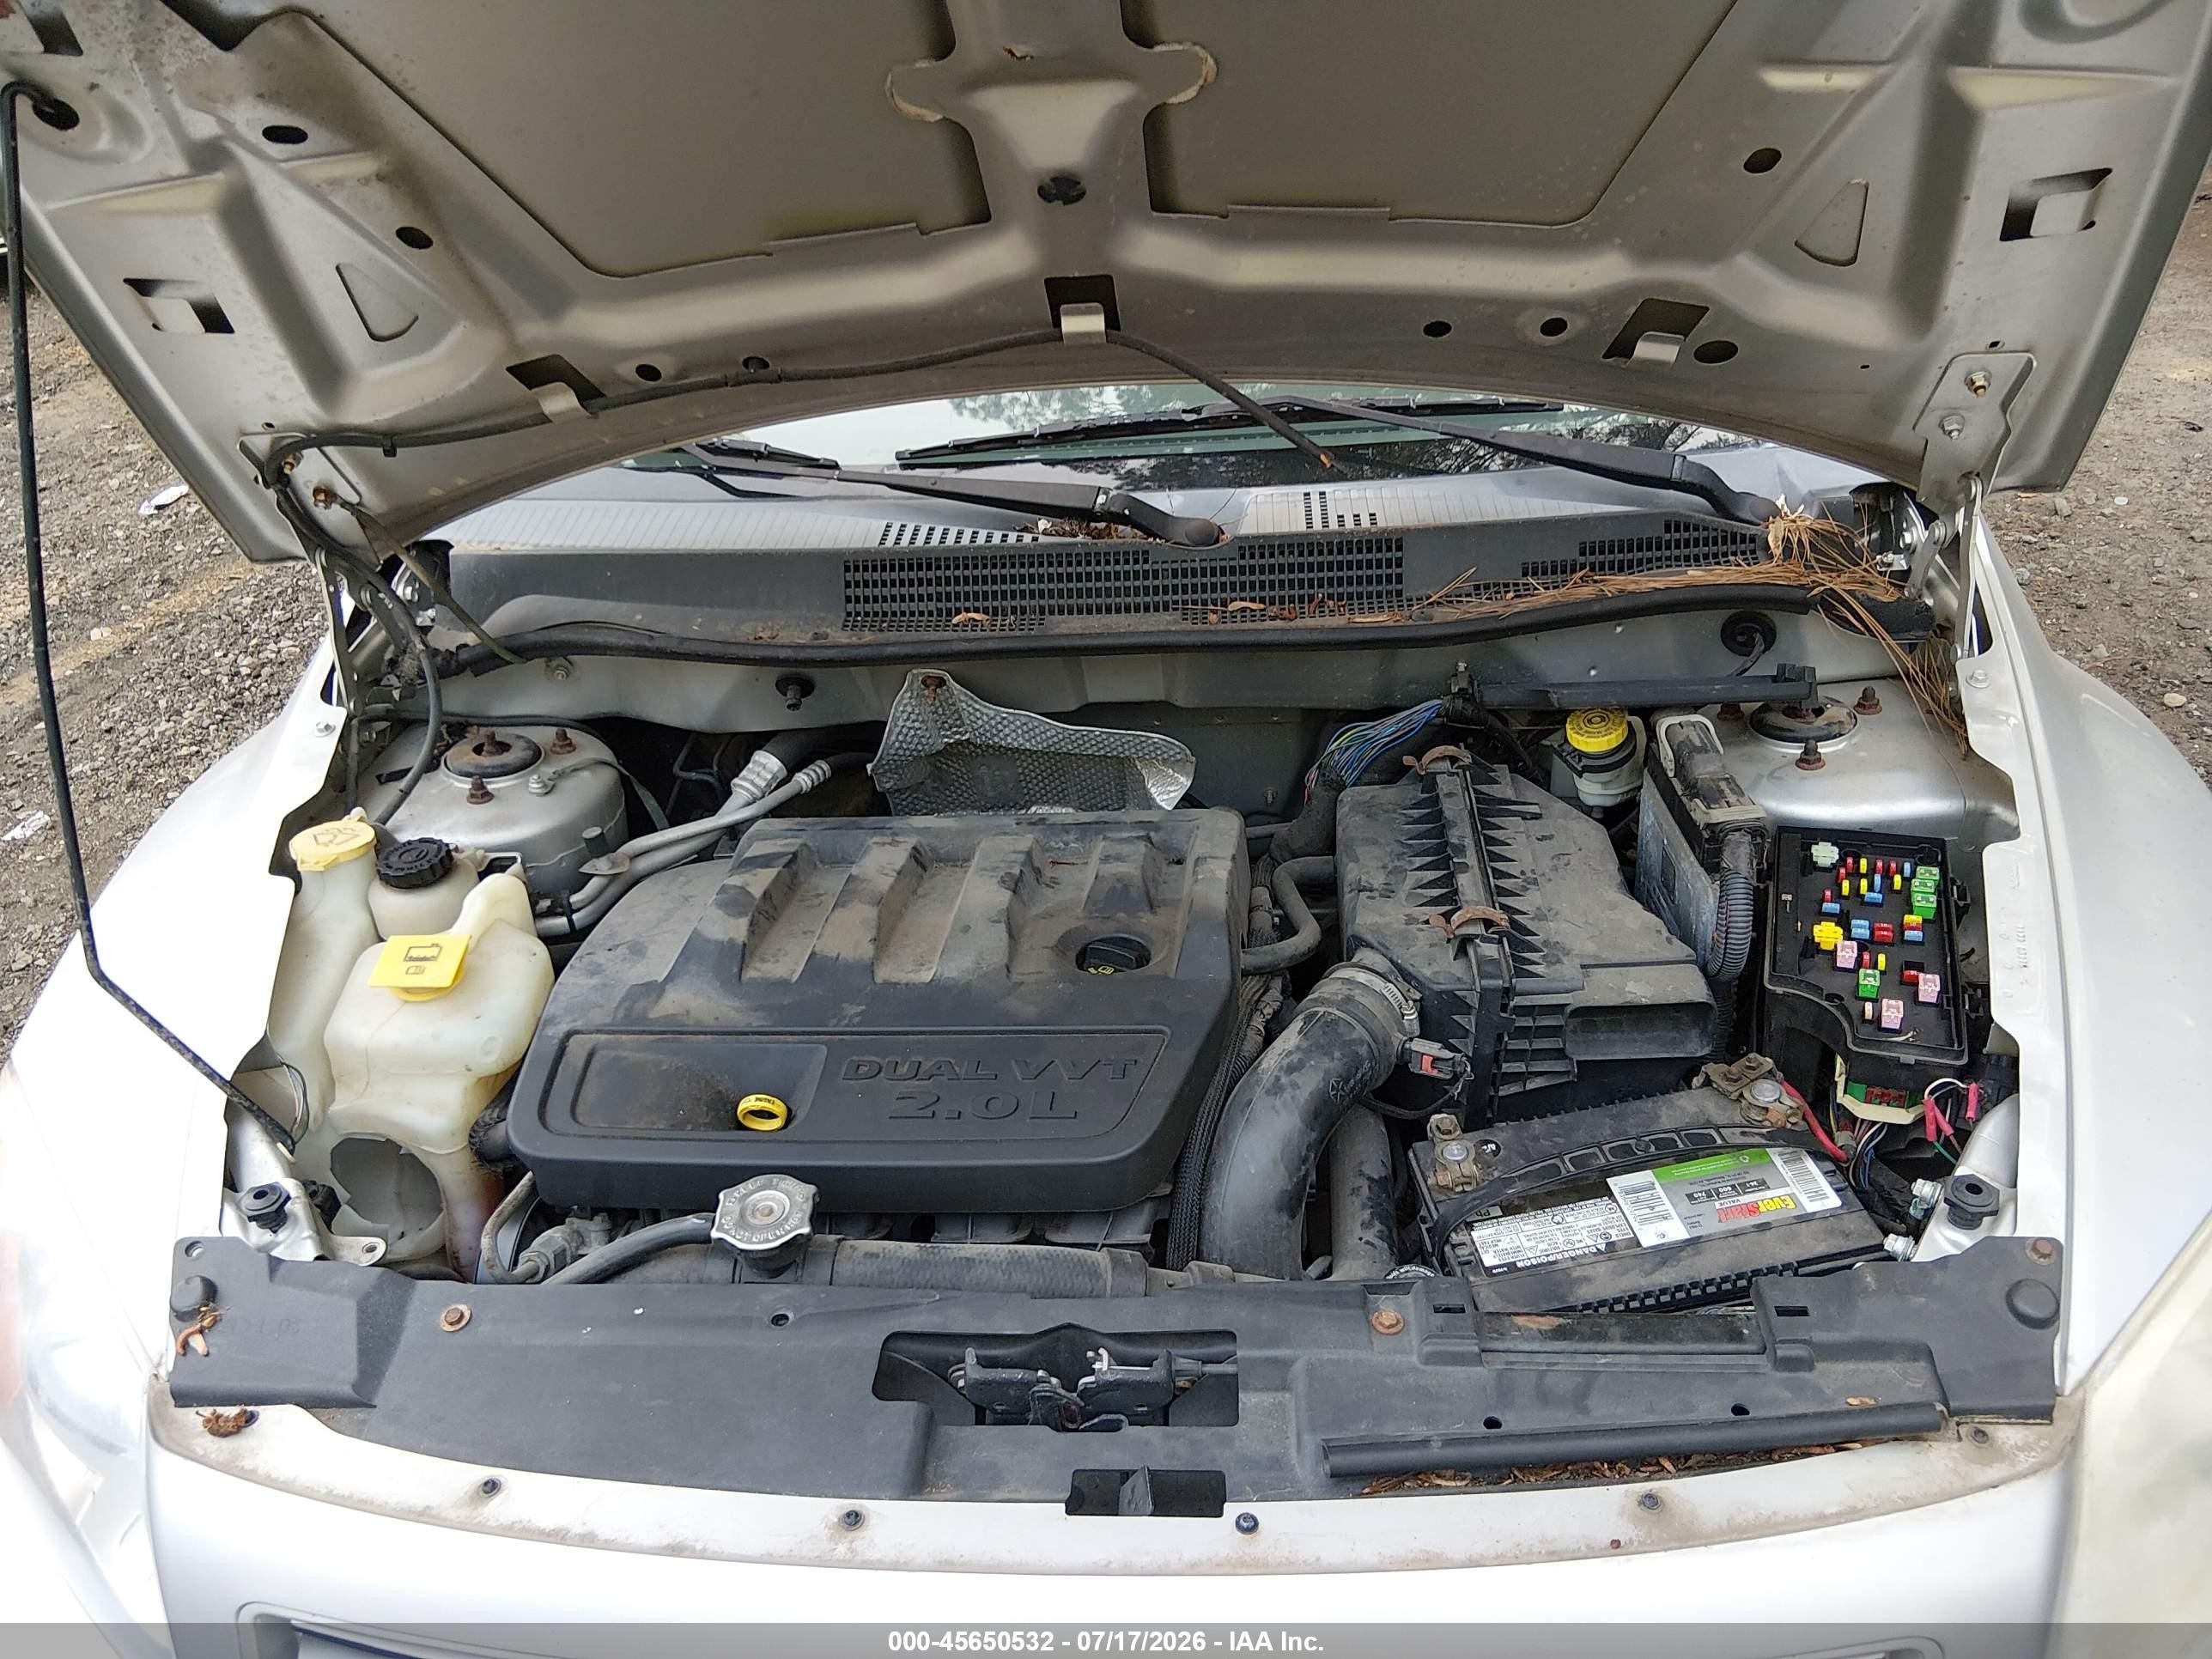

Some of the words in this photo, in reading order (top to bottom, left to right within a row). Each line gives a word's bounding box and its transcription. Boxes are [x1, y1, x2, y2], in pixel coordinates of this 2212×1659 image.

[841, 1058, 1000, 1082] DUAL
[1010, 1057, 1140, 1082] VVT
[888, 1091, 1078, 1121] 2.0L
[1717, 1198, 1741, 1206] VALUE
[1717, 1194, 1796, 1223] EverStart
[1475, 1209, 1491, 1218] Pb
[1516, 1246, 1596, 1267] DANGER/POISON
[1411, 1266, 1435, 1277] damage
